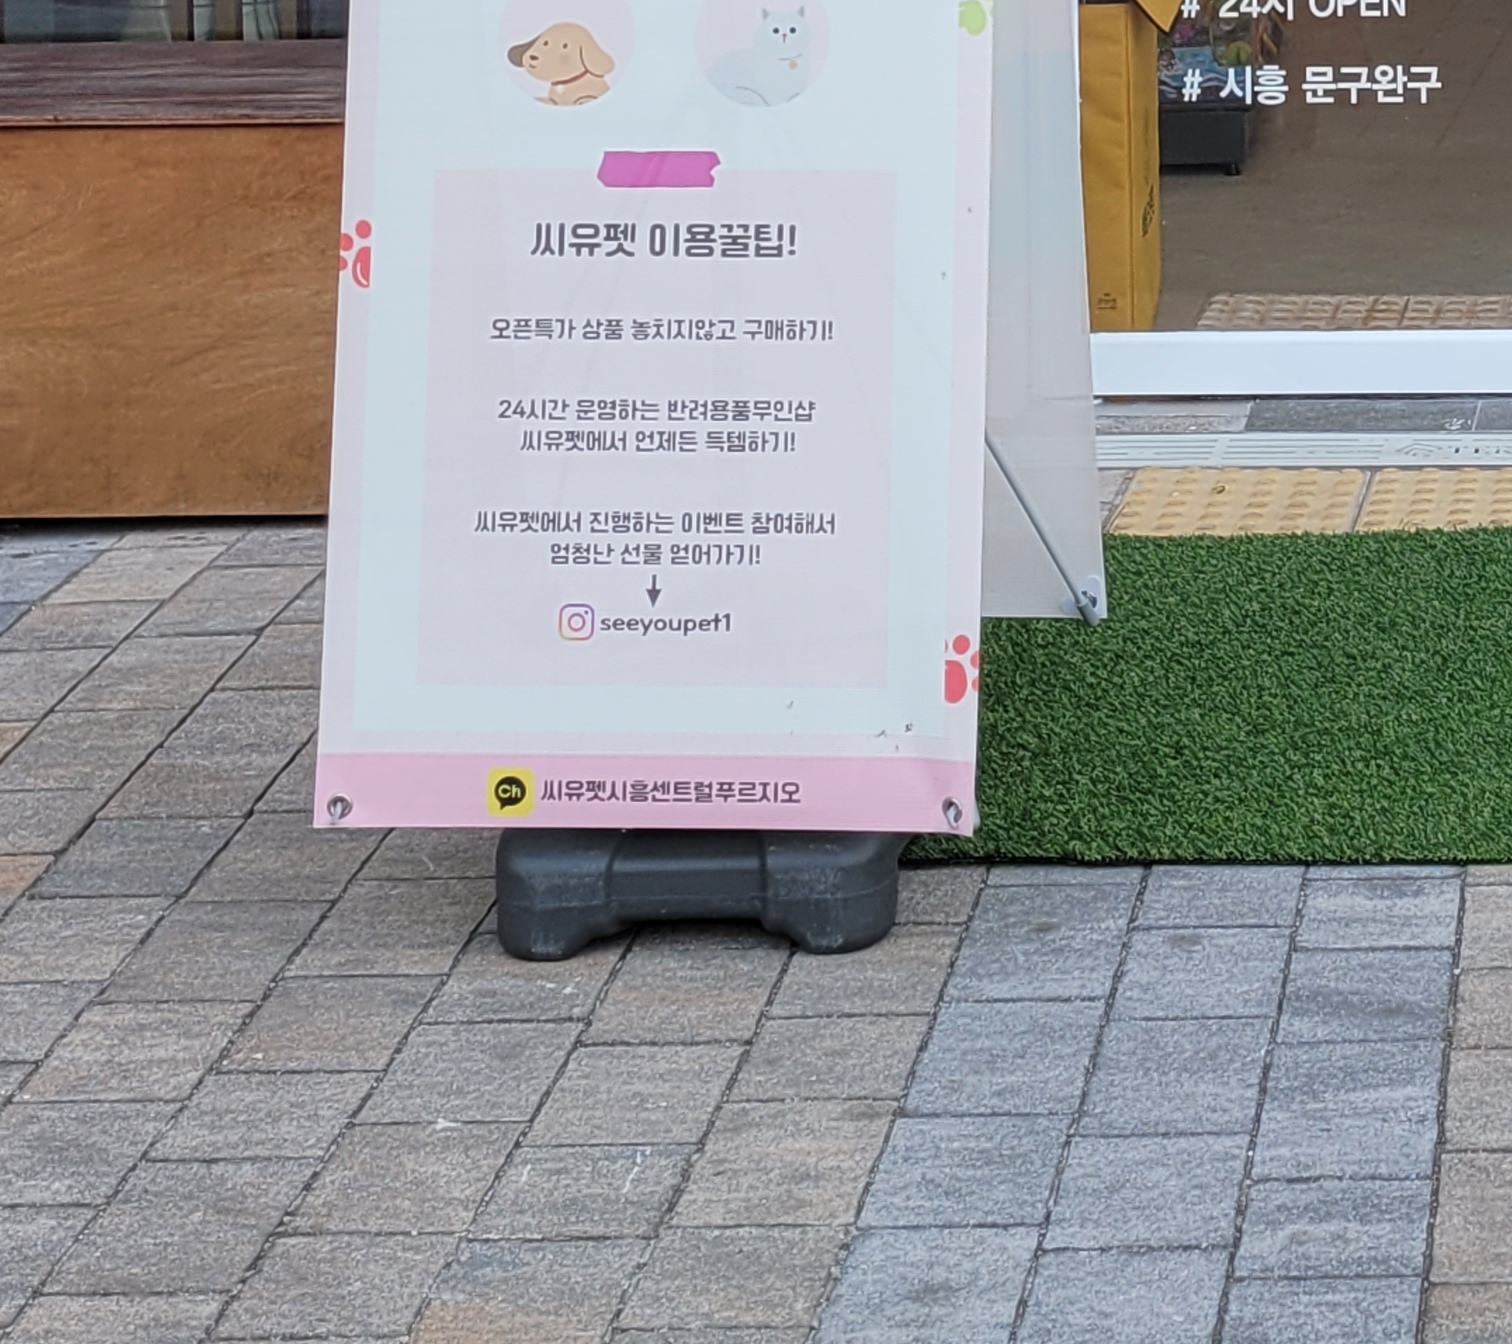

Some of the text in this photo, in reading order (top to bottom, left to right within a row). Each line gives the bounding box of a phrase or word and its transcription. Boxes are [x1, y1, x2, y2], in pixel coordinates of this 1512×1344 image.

[1182, 65, 1441, 105] # 시흥 문구완구
[531, 223, 796, 257] 씨유펫 이용꿀팁!
[491, 319, 832, 341] 오픈특가 상품 놓치지않고 구매하기!
[498, 399, 815, 421] 24시간 운영하는 반려용품무인샵
[521, 430, 795, 452] 씨유펫에서 언제든 득템하기!
[475, 511, 835, 534] 씨유펫에서 진행하는 이벤트 참여해서
[551, 543, 760, 565] 엄청난 선물 얻어가기!
[601, 613, 730, 636] seeyoupet1
[498, 784, 521, 798] Ch
[541, 780, 800, 803] 씨유펫시흥센트럴푸르지오
